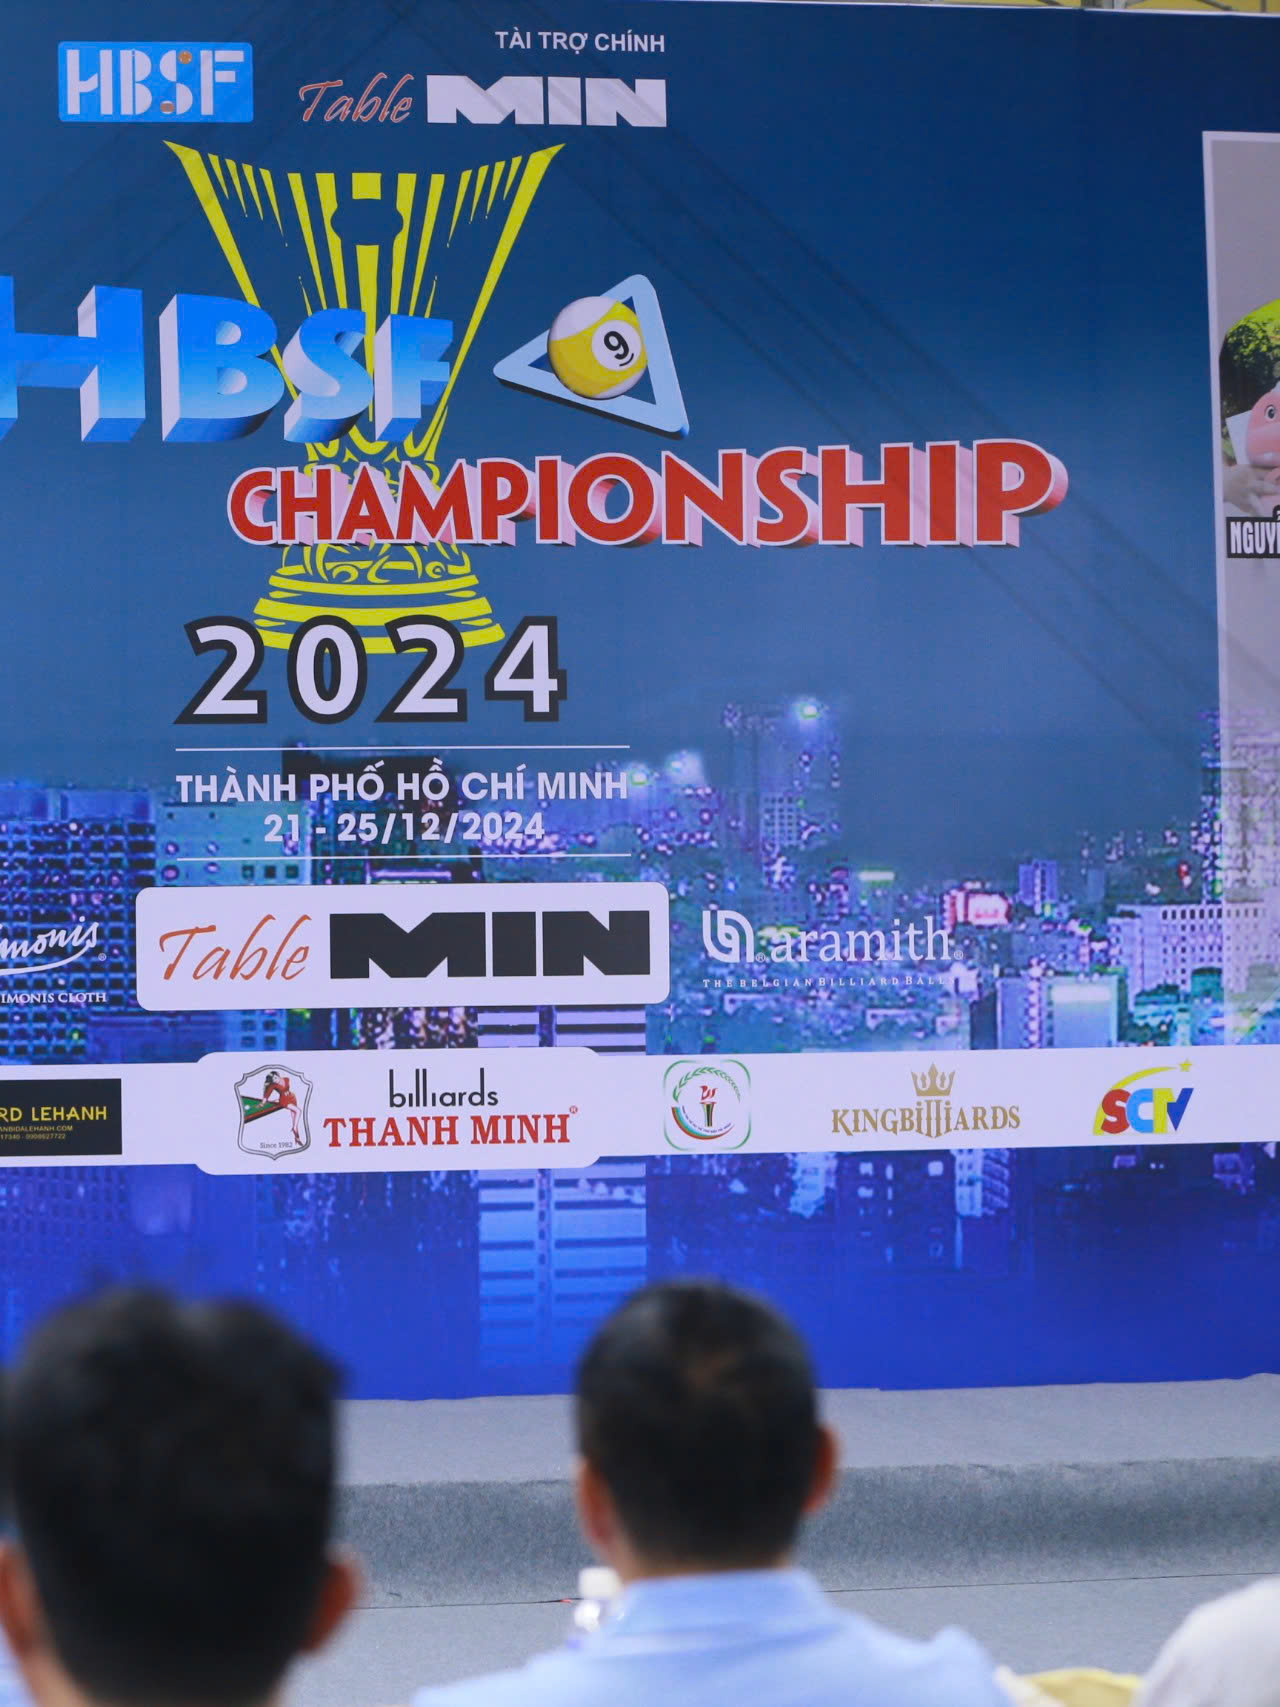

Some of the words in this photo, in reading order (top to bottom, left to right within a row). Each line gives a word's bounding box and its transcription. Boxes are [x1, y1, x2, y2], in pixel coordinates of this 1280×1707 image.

[495, 26, 531, 50] TÀI
[538, 31, 589, 55] TRỢ
[595, 29, 665, 53] CHÍNH
[66, 48, 245, 116] HBSF
[299, 73, 414, 123] Table
[427, 75, 667, 127] MIN
[604, 330, 635, 367] 9
[227, 437, 1068, 548] CHAMPIONSHIP
[174, 616, 567, 723] 2024
[176, 765, 296, 803] THÀNH
[310, 759, 385, 801] PHỐ
[397, 757, 450, 801] HỒ
[461, 763, 527, 800] CHÍ
[538, 771, 629, 800] MINH
[263, 814, 300, 842] 21
[337, 812, 546, 844] 25/12/2024
[158, 913, 313, 981] Table
[330, 910, 651, 978] MIN
[770, 916, 952, 962] aramith
[57, 991, 107, 1003] CLOTH
[703, 978, 733, 987] THE
[739, 978, 813, 987] BELGIAN
[819, 976, 899, 986] BILLIARD
[389, 1067, 499, 1108] billiards
[32, 1105, 108, 1122] LEHANH
[323, 1115, 460, 1147] THANH
[470, 1114, 571, 1146] MINH
[1100, 1087, 1195, 1135] SCTV
[260, 1141, 277, 1150] Since
